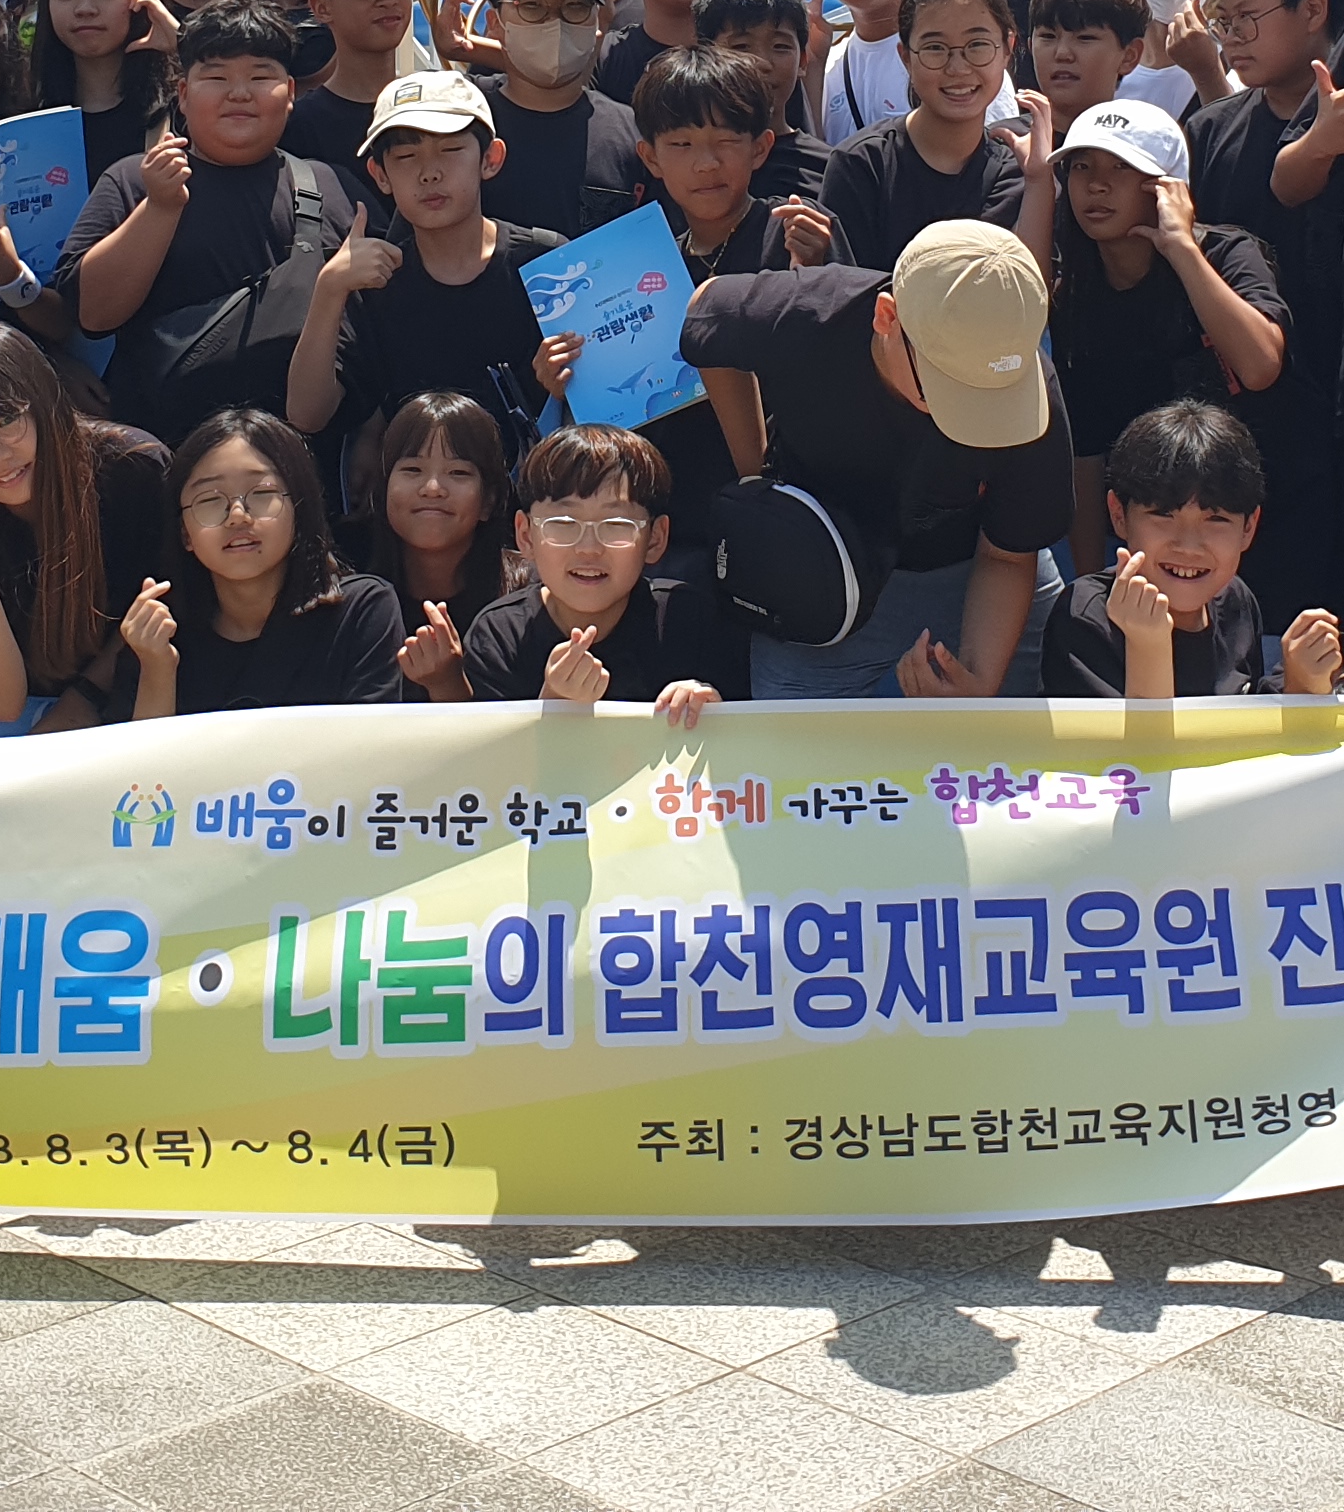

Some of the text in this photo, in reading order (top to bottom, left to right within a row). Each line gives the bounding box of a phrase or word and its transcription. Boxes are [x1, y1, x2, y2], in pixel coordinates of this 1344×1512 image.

[594, 304, 655, 343] 관람생활
[196, 779, 345, 850] 배움이
[367, 793, 488, 850] 즐거운
[506, 792, 587, 844] 학교
[655, 773, 765, 837] 함께
[789, 782, 908, 824] 가꾸는
[930, 767, 1151, 825] 합천교육
[272, 910, 566, 1046] 나눔의
[598, 888, 1241, 1034] 합천영재교육원
[46, 1134, 89, 1166] 8.
[105, 1126, 213, 1169] 3(목)
[287, 1129, 329, 1166] 8.
[348, 1123, 457, 1168] 4(금)
[636, 1116, 727, 1162] 주최
